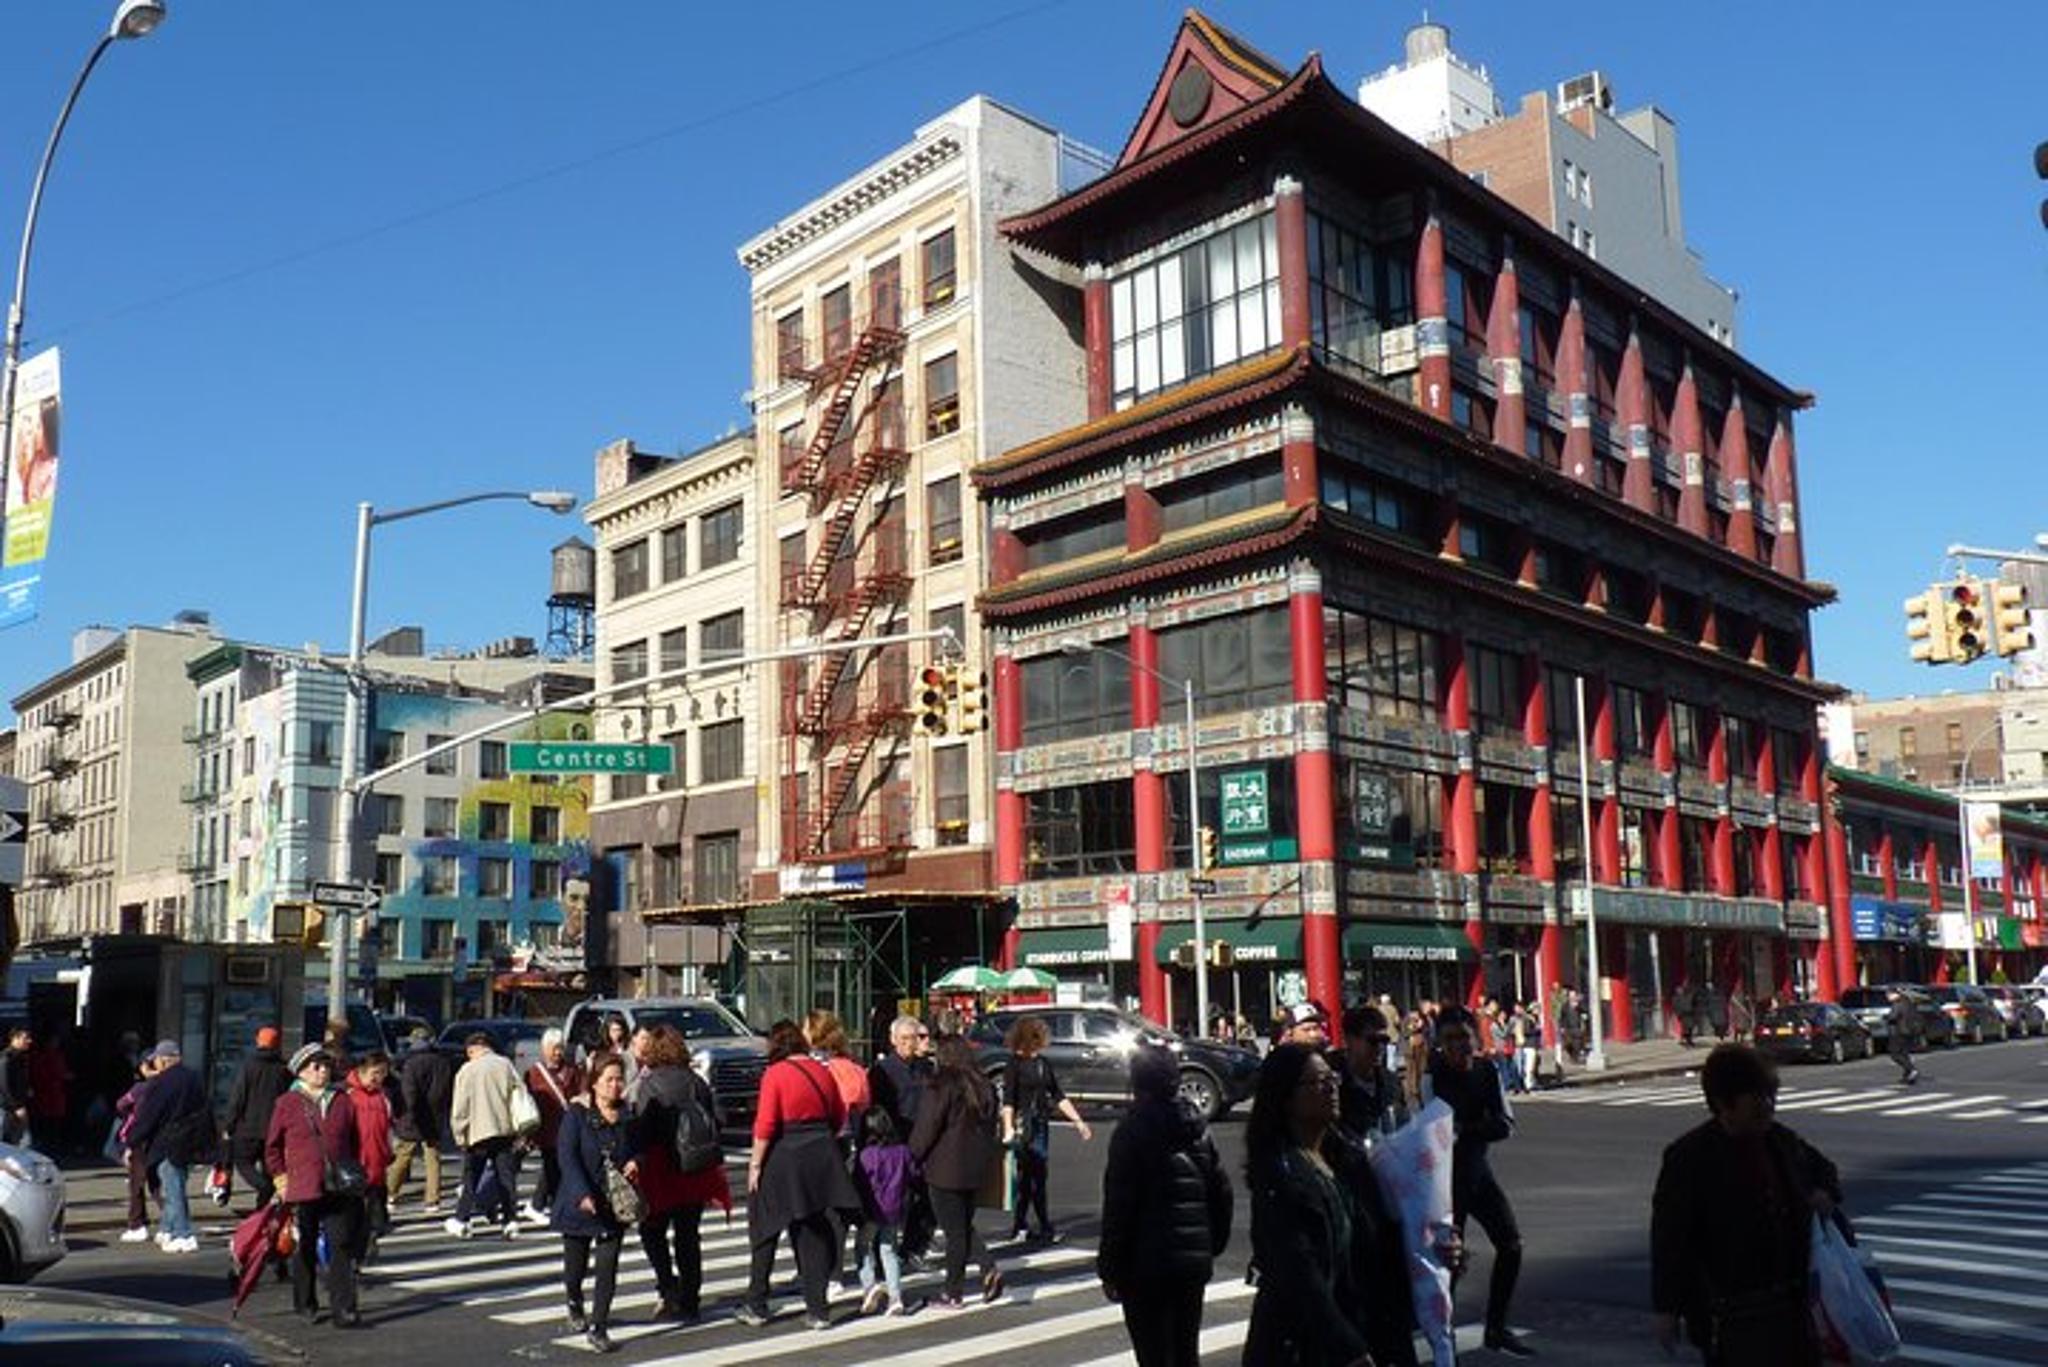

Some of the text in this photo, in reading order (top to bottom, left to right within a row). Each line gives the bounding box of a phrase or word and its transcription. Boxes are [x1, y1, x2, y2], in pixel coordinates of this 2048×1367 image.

[537, 749, 648, 767] Centre St
[1025, 950, 1078, 965] STARBUCKS
[1235, 945, 1277, 960] COFFEE
[1372, 945, 1457, 960] STARBUCKS COFFEE
